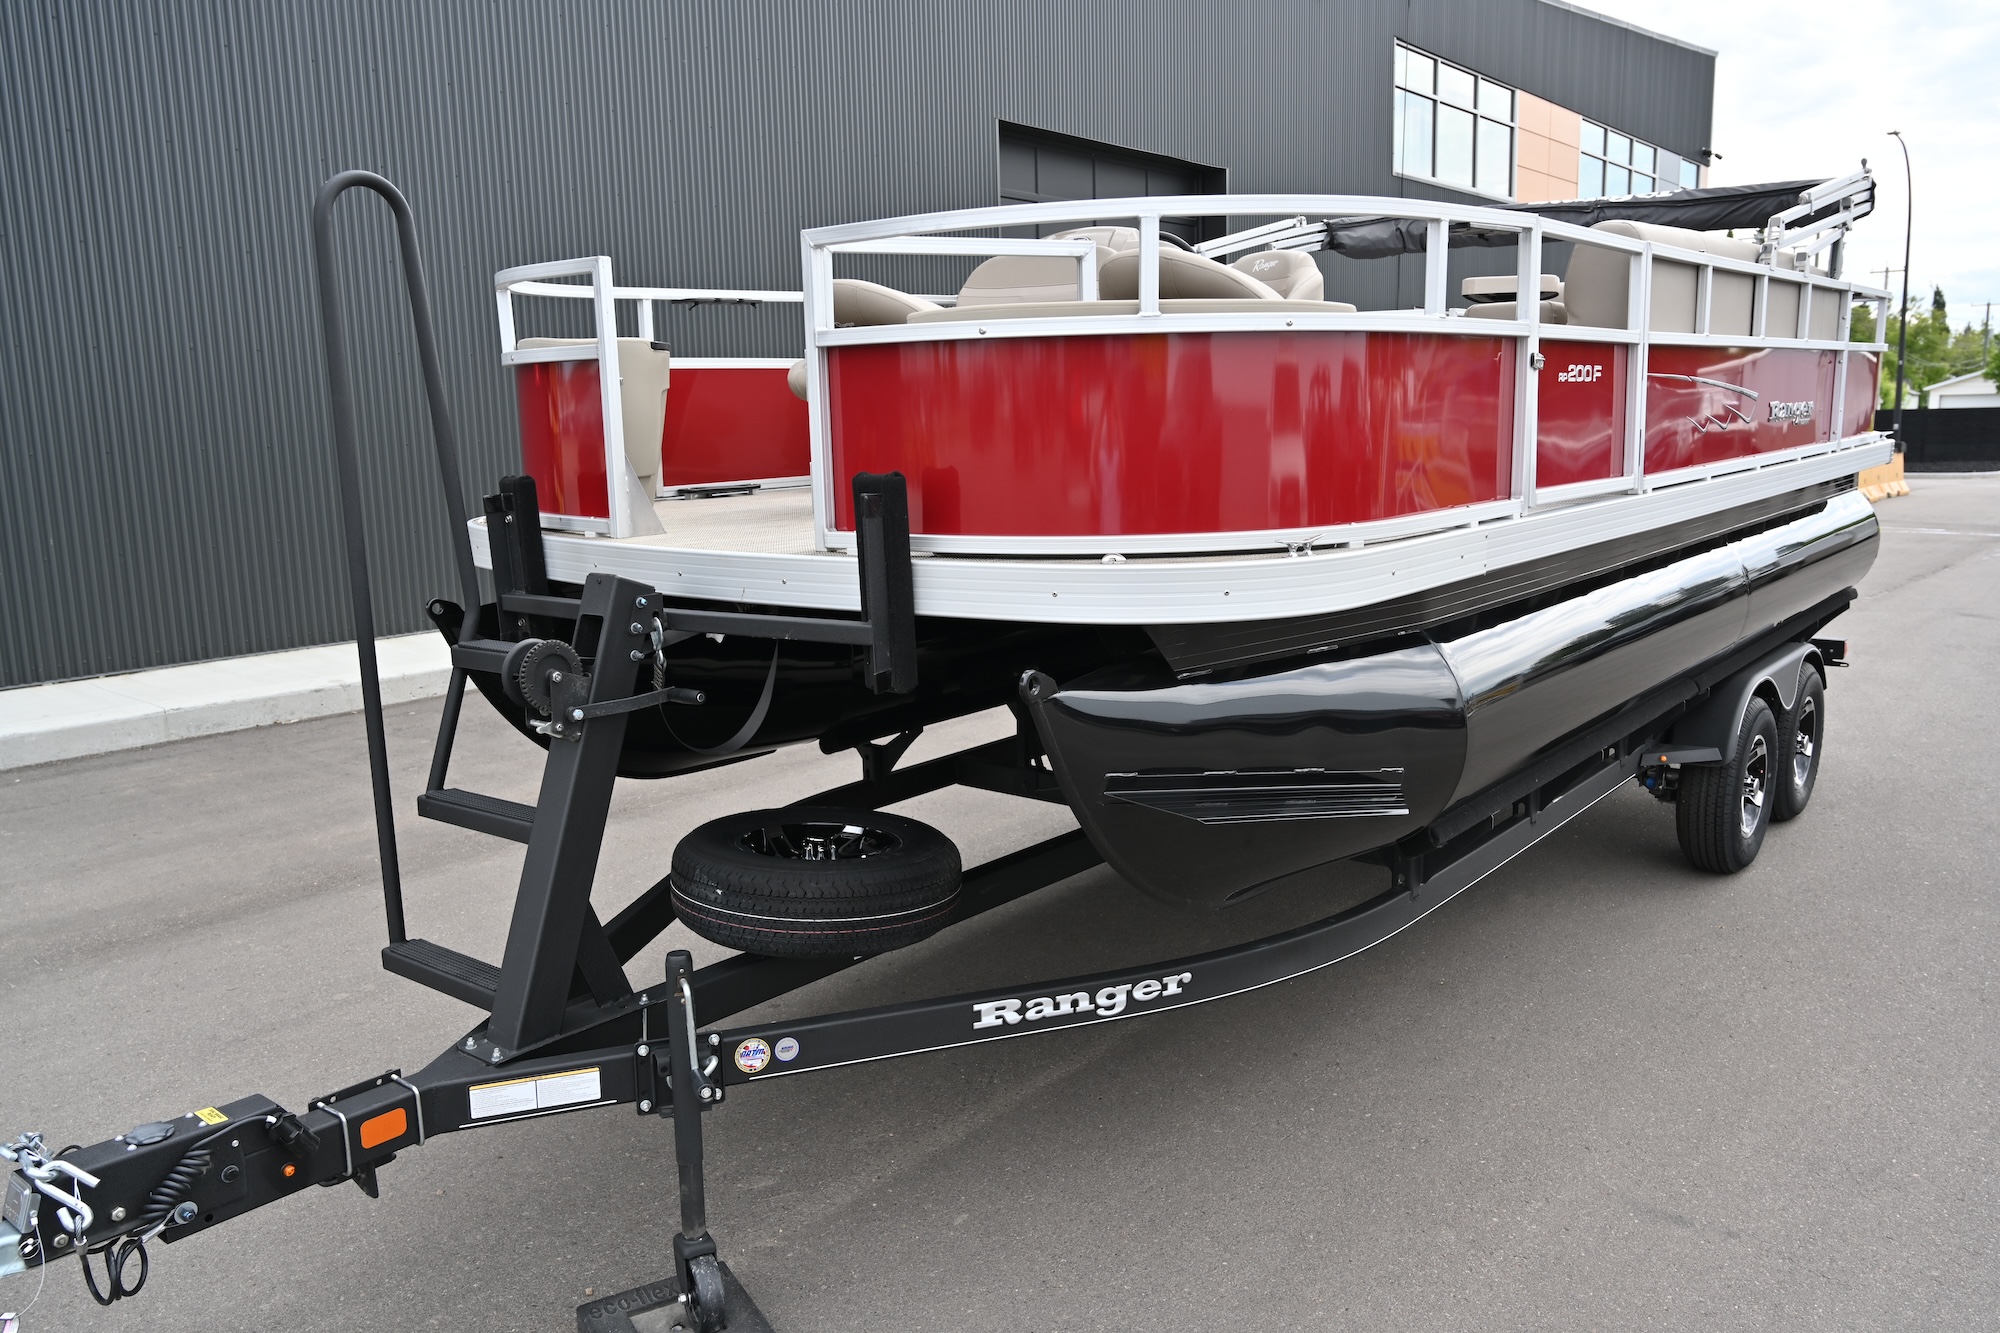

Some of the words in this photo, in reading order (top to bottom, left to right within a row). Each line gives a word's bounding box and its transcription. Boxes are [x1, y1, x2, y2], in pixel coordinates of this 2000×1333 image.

[1252, 259, 1279, 272] Ranger
[1768, 400, 1814, 426] Ranger
[973, 972, 1192, 1030] Ranger
